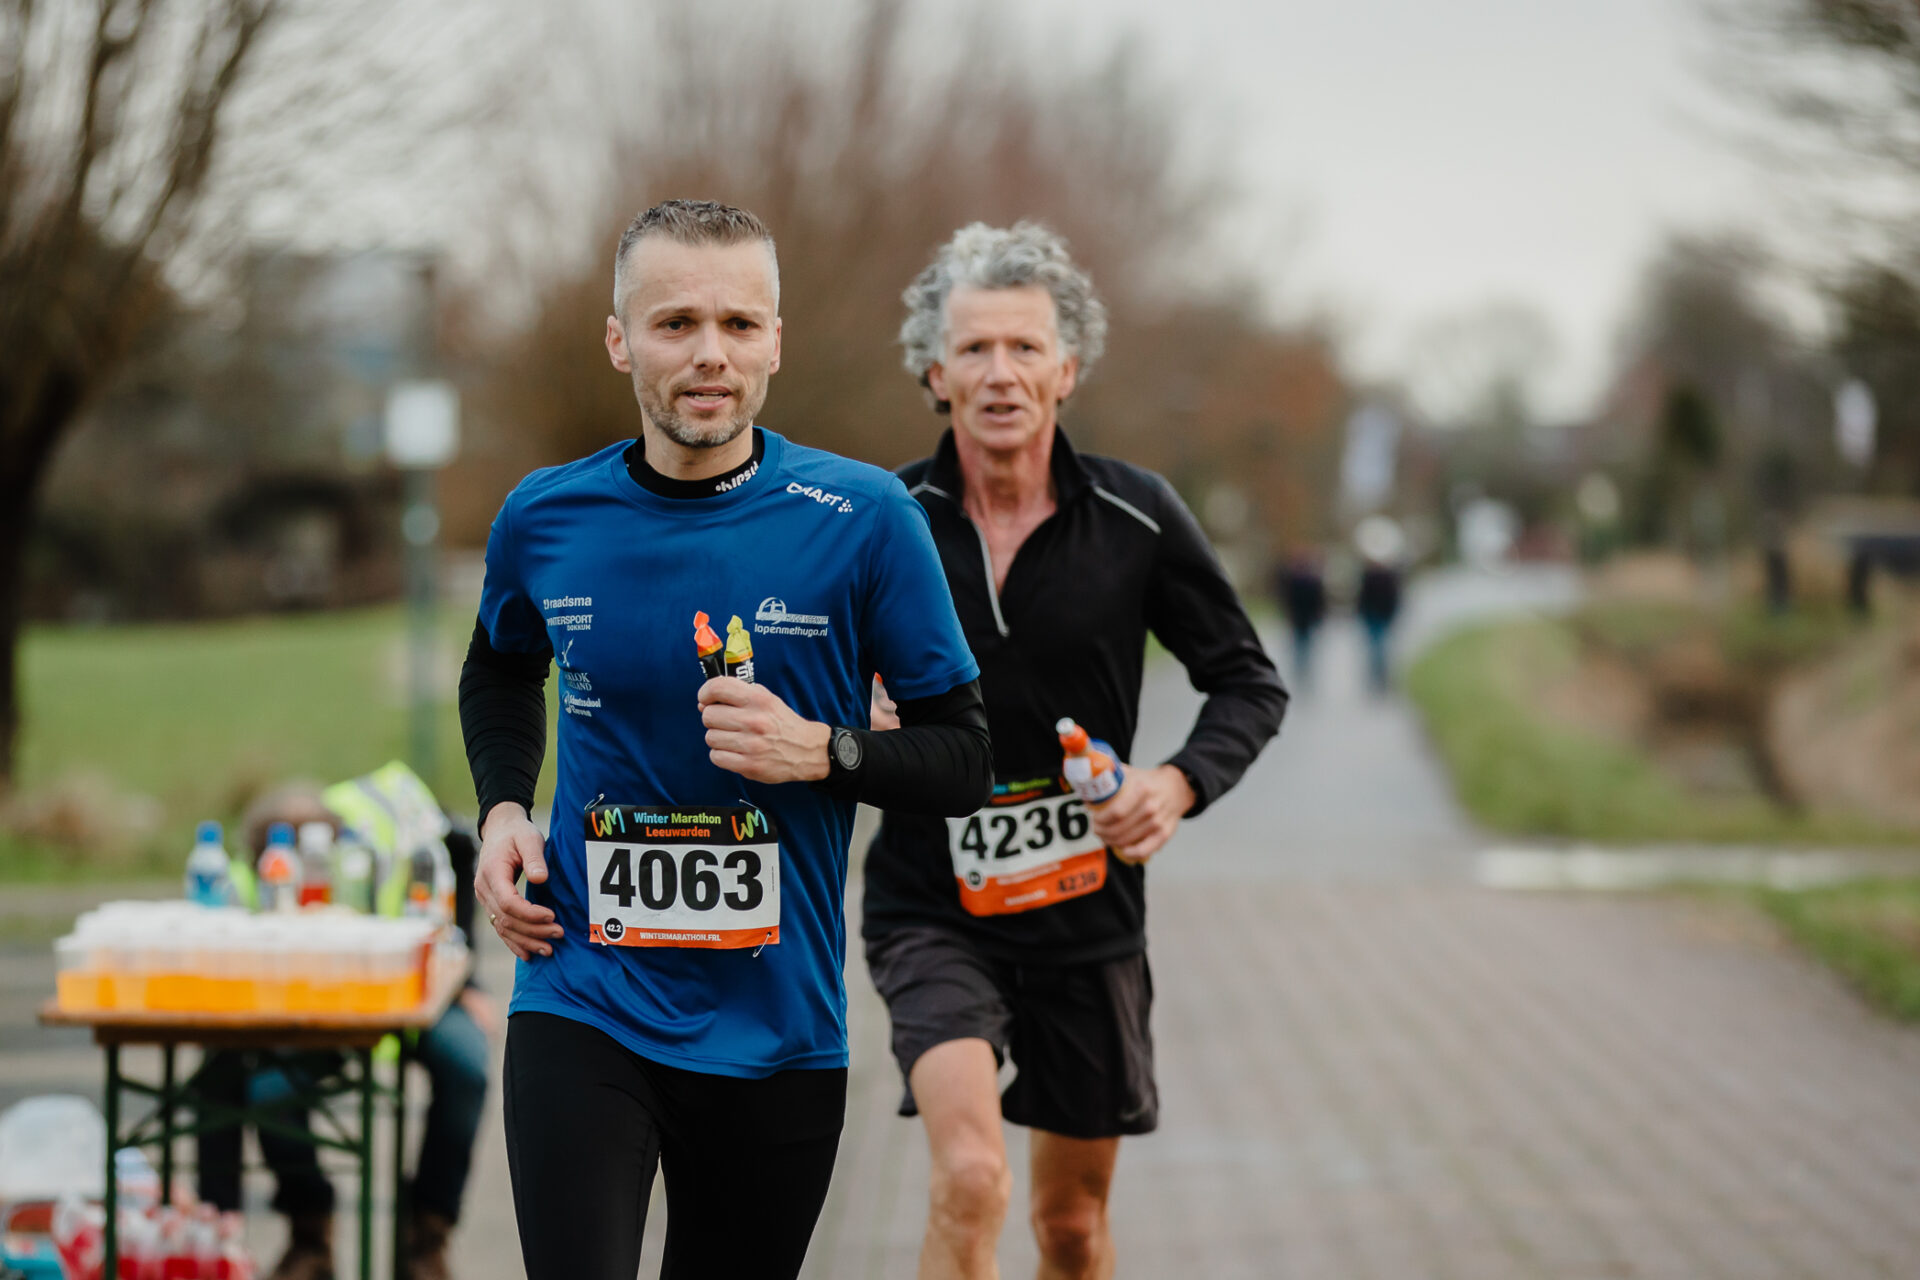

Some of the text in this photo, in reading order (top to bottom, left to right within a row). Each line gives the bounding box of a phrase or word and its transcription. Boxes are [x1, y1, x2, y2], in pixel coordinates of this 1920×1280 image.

[754, 623, 828, 638] lopenmethugo.nl
[633, 812, 722, 825] Winter Marathon
[645, 826, 711, 838] Leeuwarden
[961, 800, 1090, 860] 4236
[600, 848, 764, 911] 4063
[640, 932, 722, 941] WINTERMARATHON.FRL
